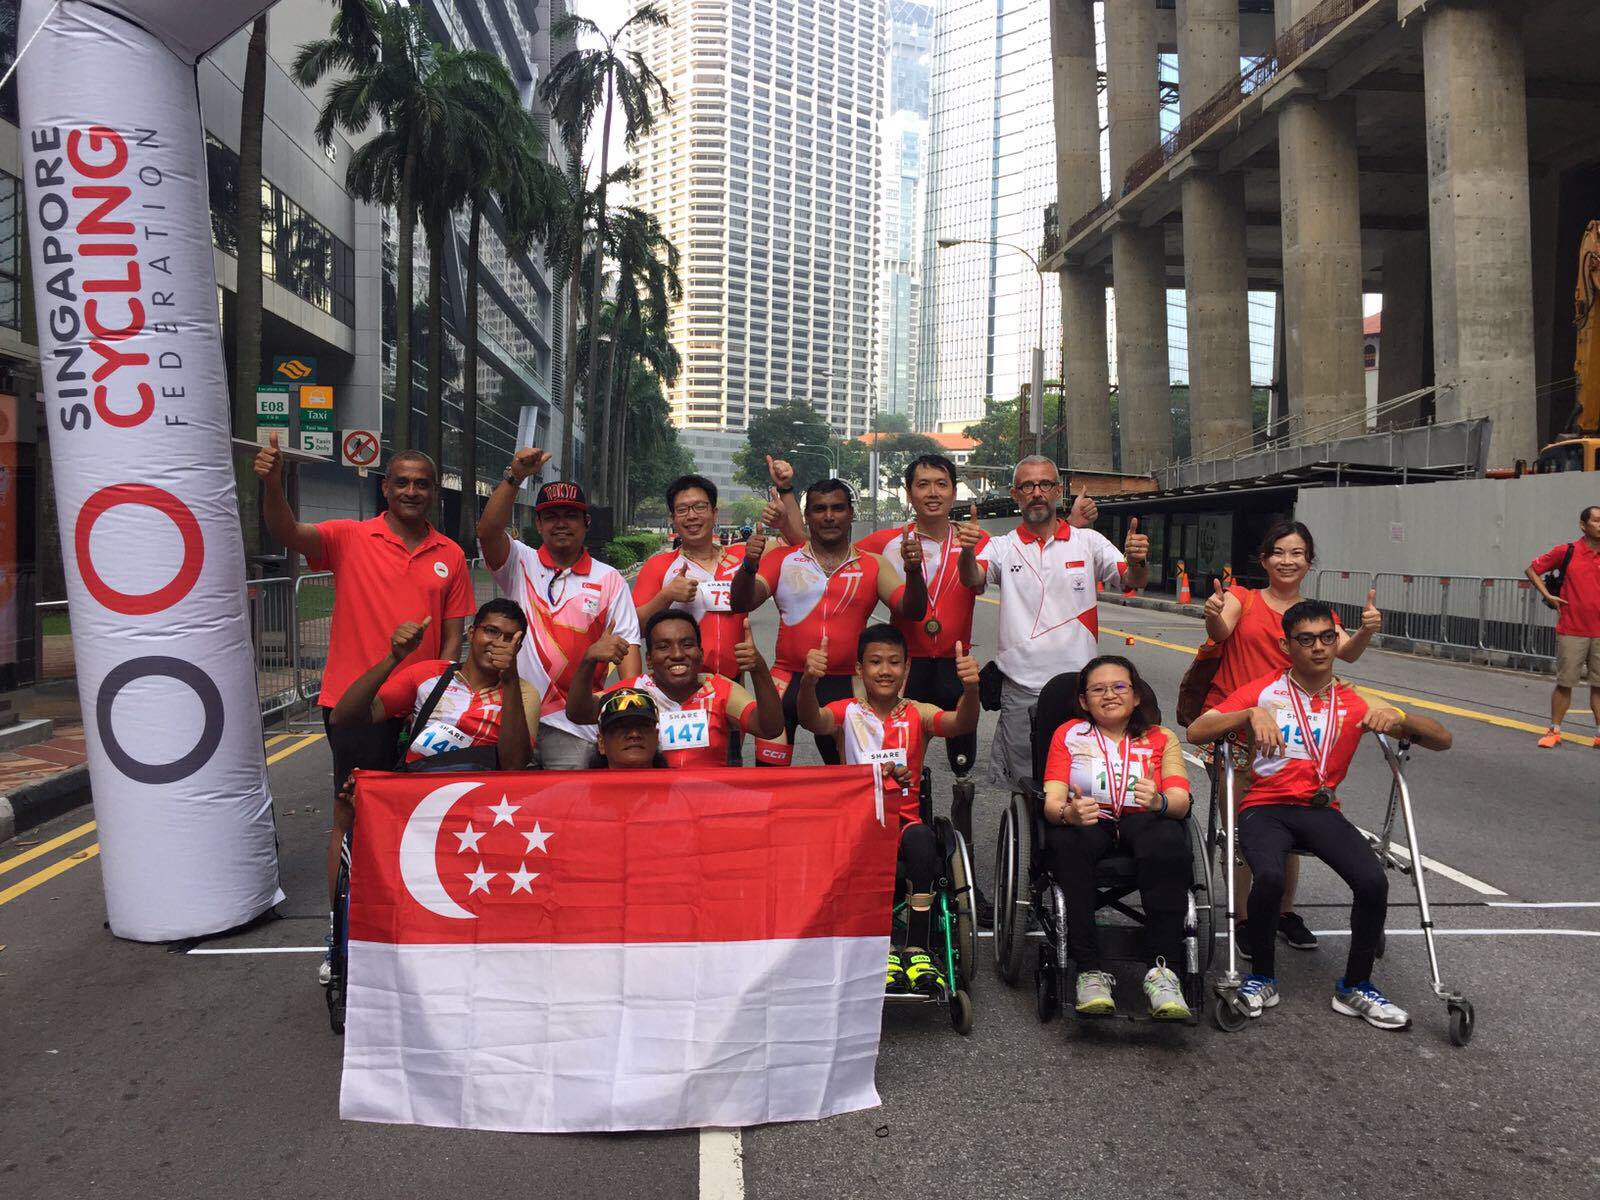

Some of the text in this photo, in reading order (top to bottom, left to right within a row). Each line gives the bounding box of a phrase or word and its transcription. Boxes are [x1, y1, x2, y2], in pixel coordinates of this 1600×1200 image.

[32, 127, 91, 430] SINGAPORE
[66, 126, 155, 428] CYCLING
[135, 128, 188, 426] FEDERATION
[261, 401, 284, 412] E08
[307, 410, 327, 420] Taxi
[304, 436, 315, 450] 5
[315, 444, 330, 452] Only
[669, 712, 698, 720] SHARE
[439, 725, 465, 742] SHARE
[664, 722, 705, 743] 147
[870, 751, 900, 760] SHARE
